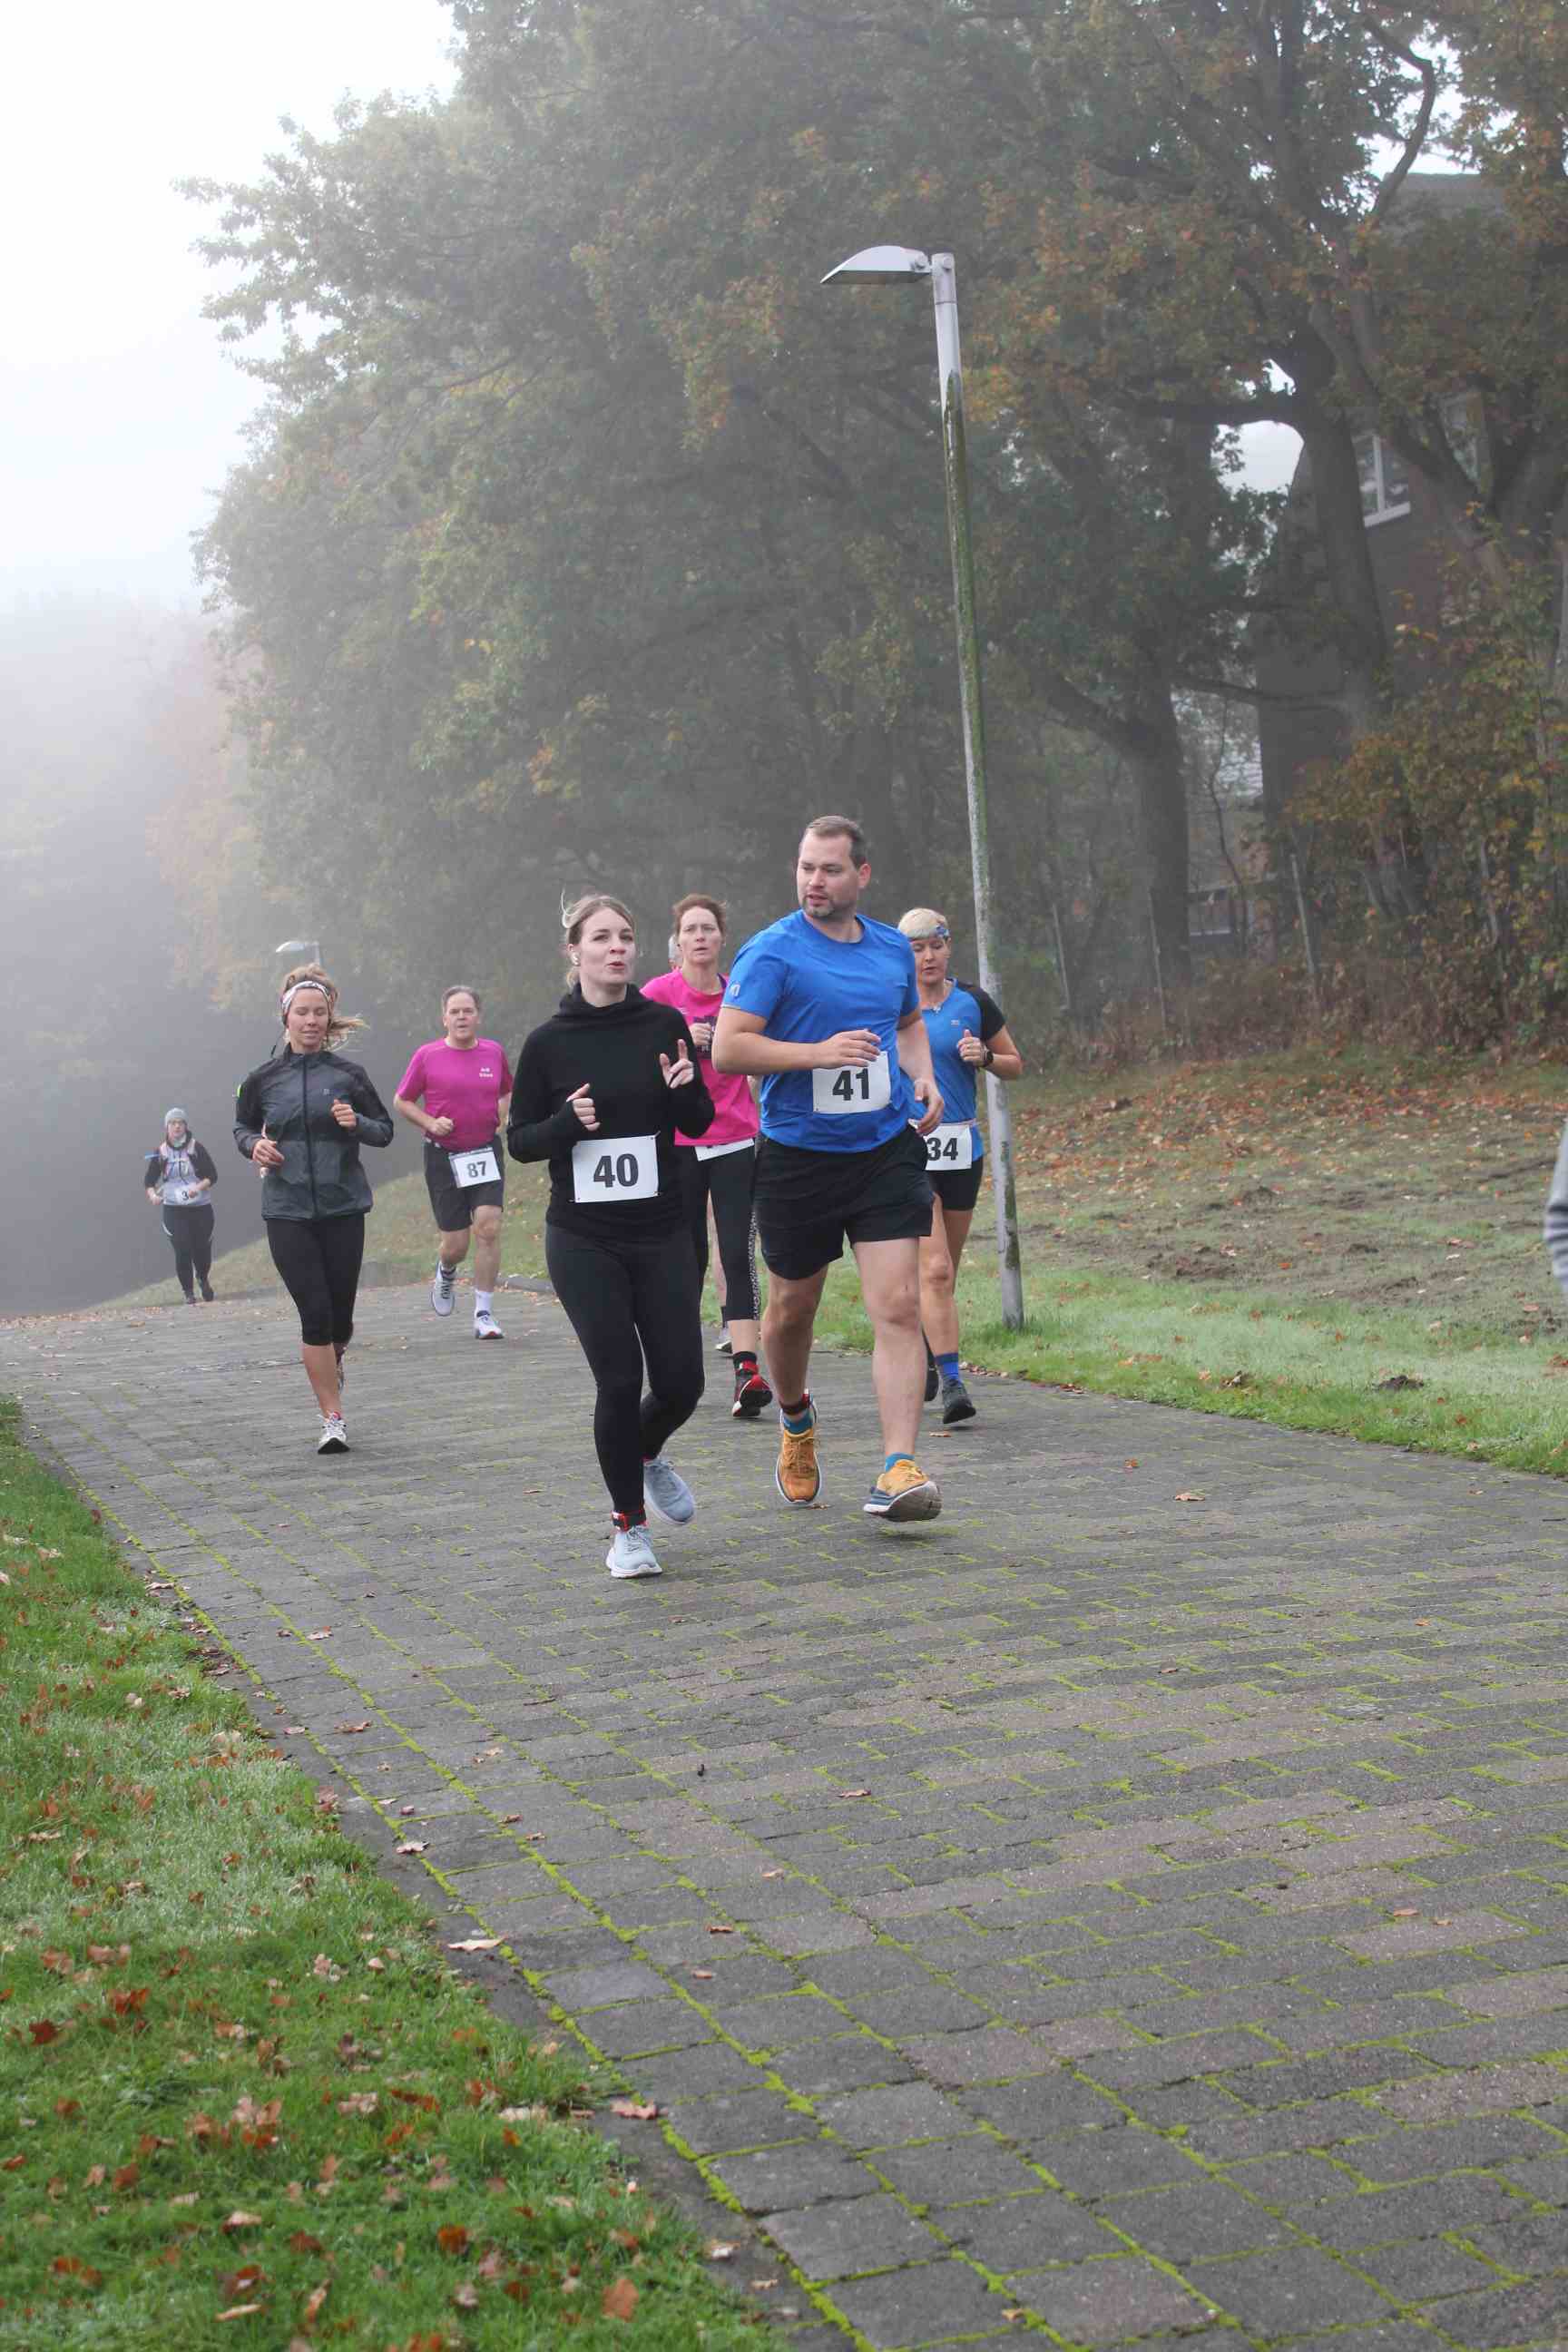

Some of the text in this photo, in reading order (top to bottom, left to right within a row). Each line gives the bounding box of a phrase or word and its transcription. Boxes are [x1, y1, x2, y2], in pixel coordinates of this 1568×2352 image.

[832, 1068, 869, 1101] 41
[926, 1137, 958, 1161] 34
[466, 1161, 486, 1178] 87
[593, 1152, 639, 1188] 40
